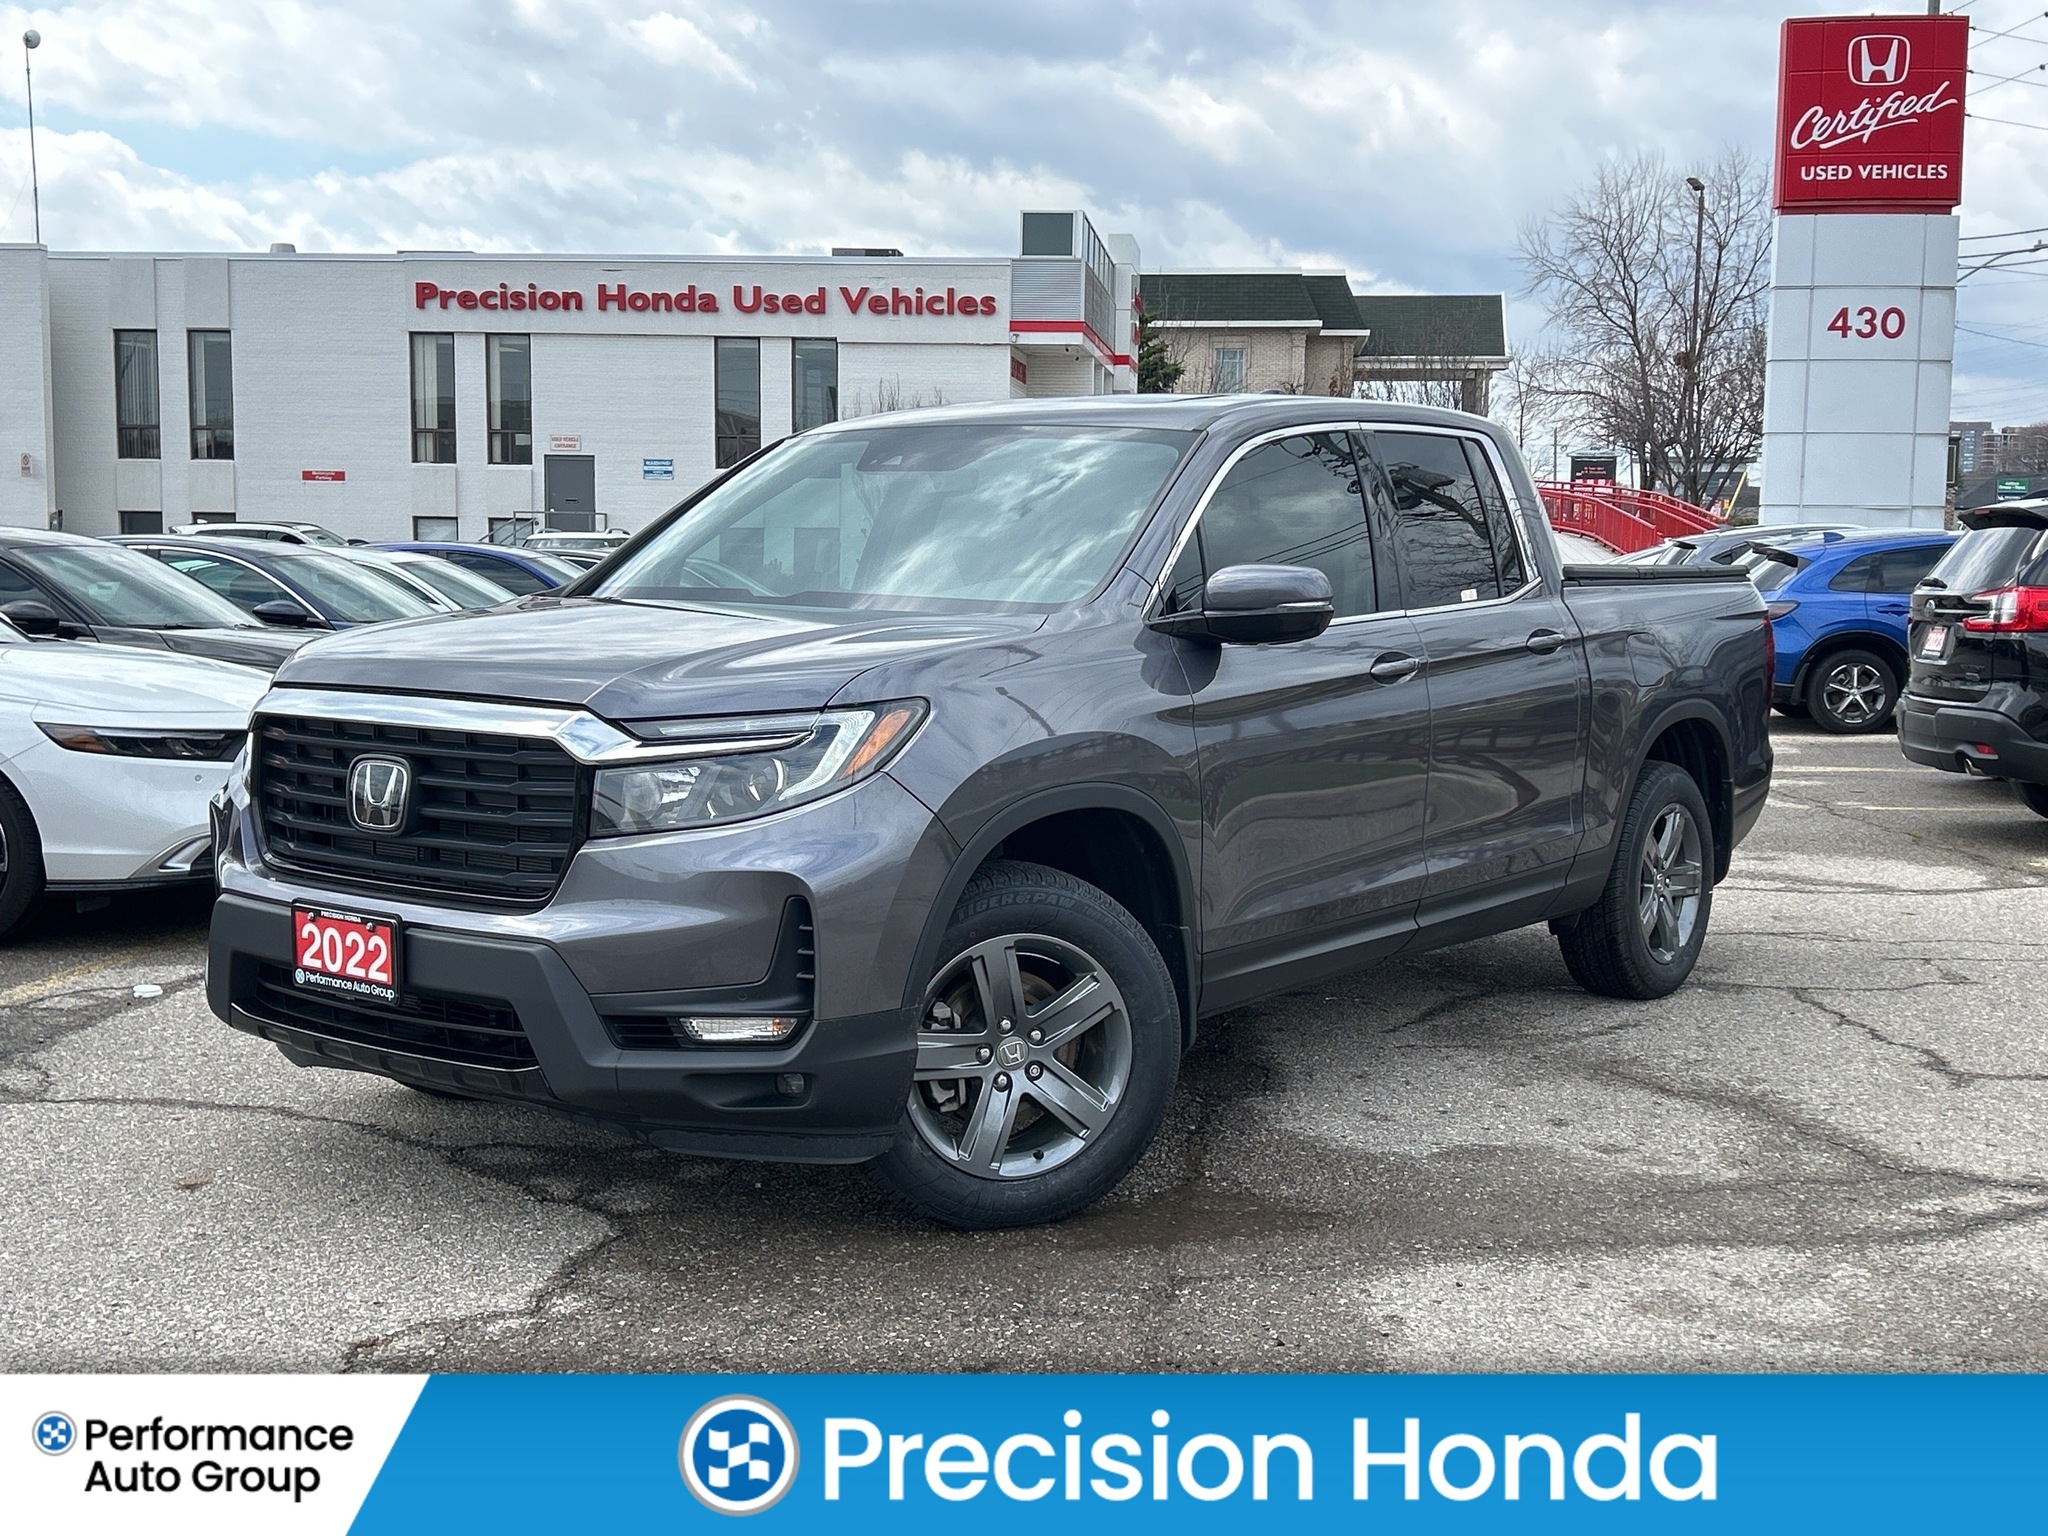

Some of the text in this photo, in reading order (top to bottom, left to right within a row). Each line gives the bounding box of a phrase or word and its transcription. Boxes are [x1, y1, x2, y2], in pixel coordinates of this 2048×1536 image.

[1790, 80, 1959, 150] Certified
[1801, 164, 1948, 181] USED VEHICLES
[415, 281, 997, 316] Precision Honda Used Vehicles
[1827, 306, 1906, 339] 430
[957, 893, 1015, 921] TIGER
[1032, 892, 1077, 909] PAW
[301, 923, 388, 982] 2022
[305, 972, 394, 1001] Performance Auto Group
